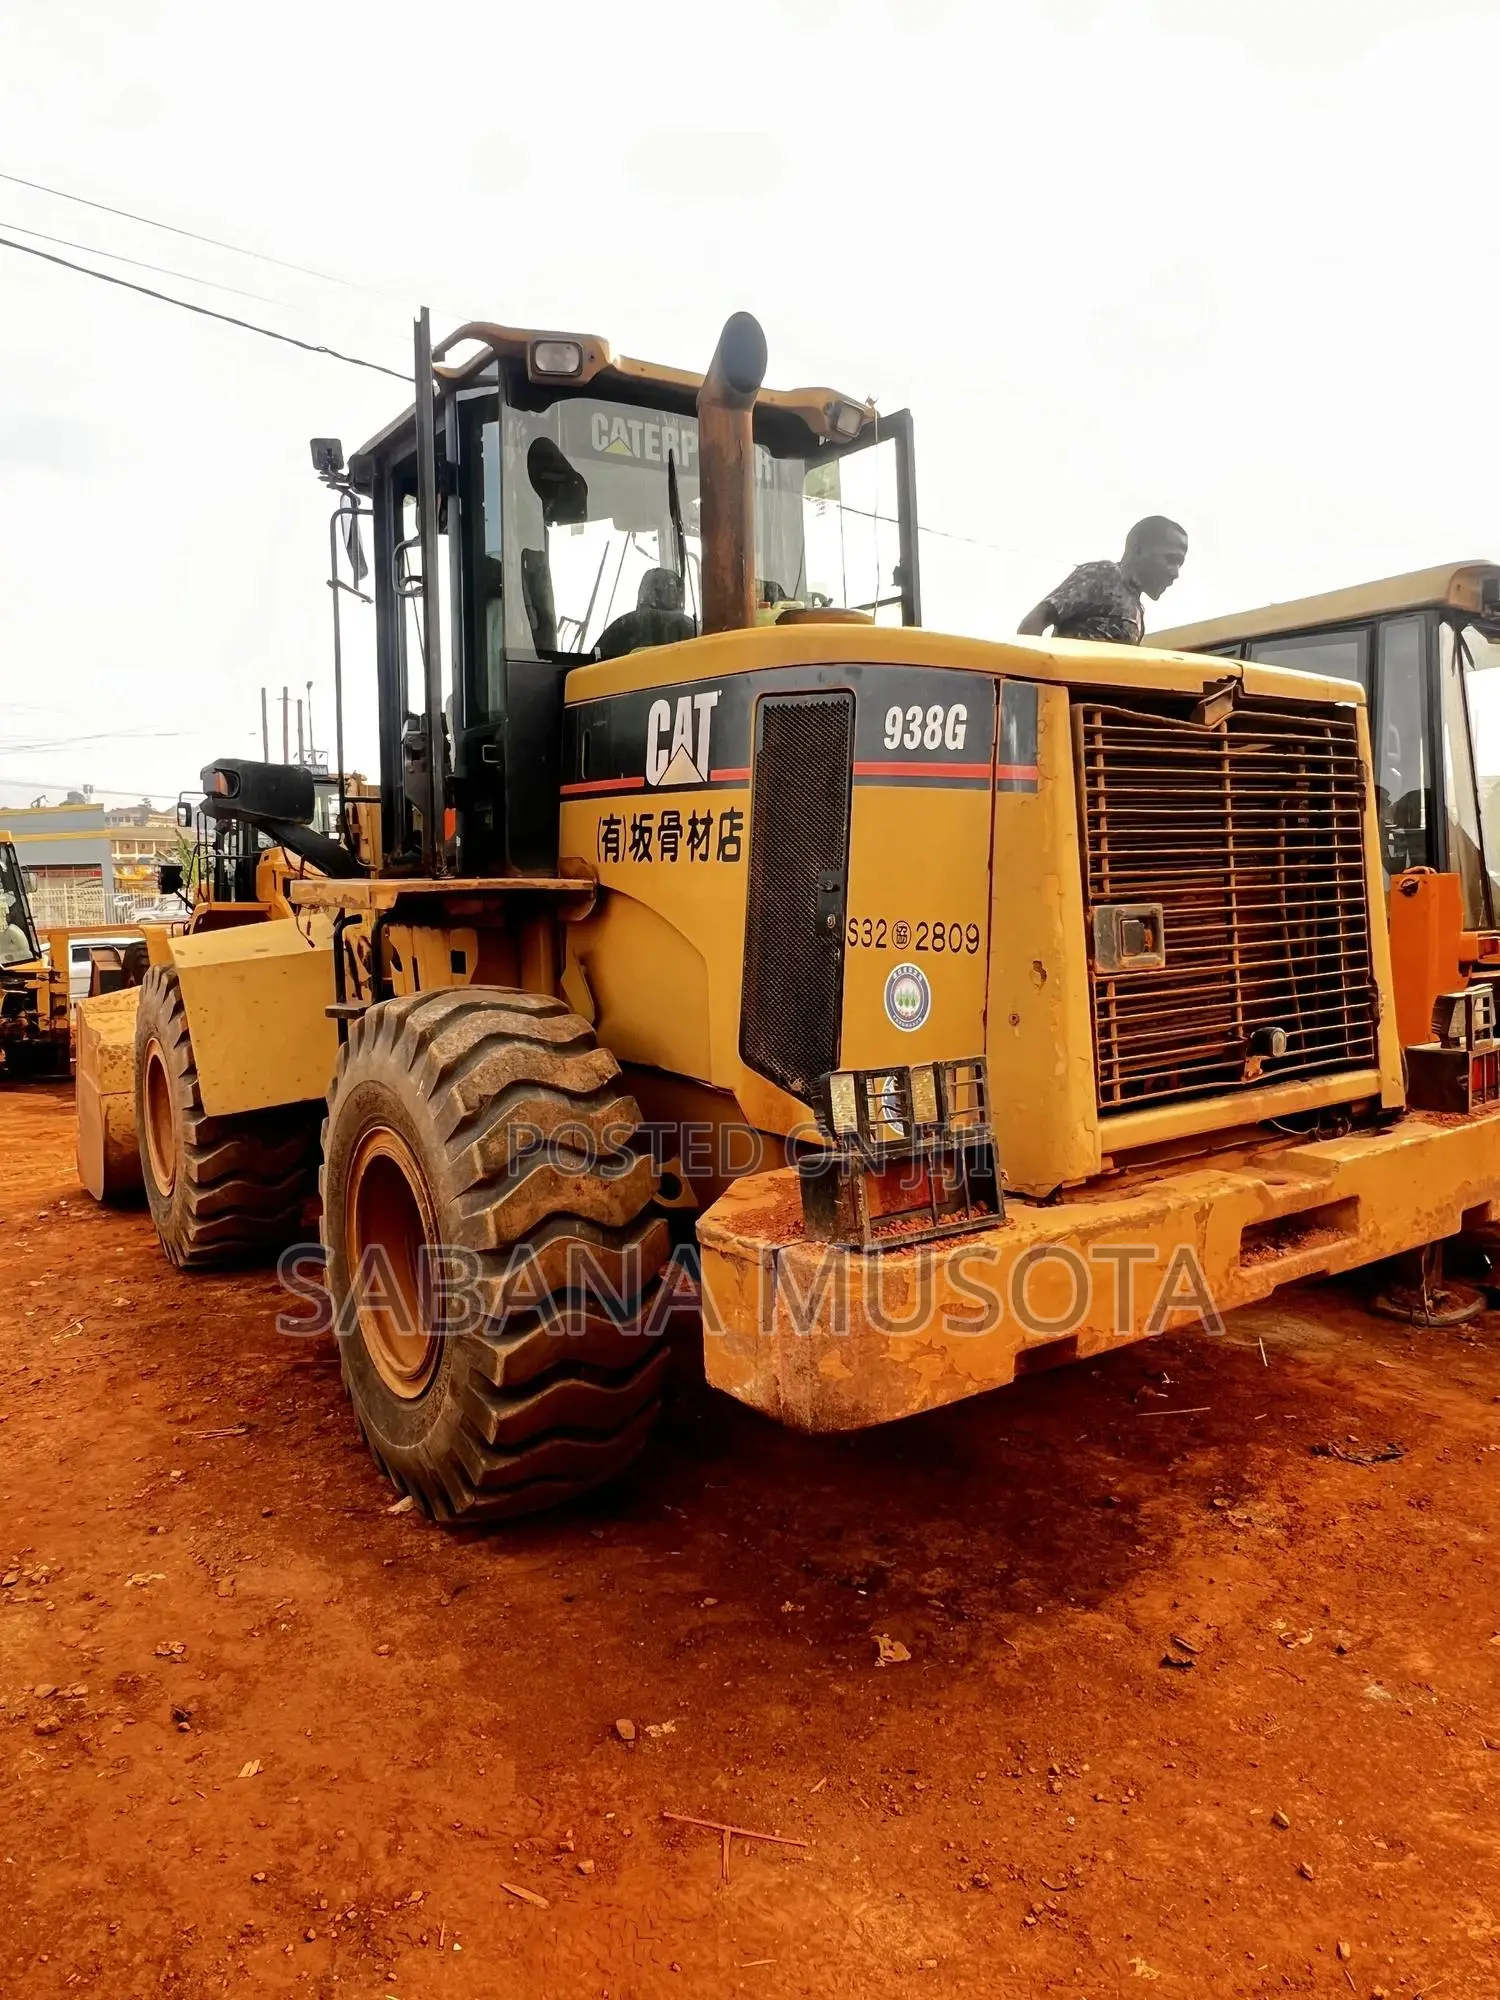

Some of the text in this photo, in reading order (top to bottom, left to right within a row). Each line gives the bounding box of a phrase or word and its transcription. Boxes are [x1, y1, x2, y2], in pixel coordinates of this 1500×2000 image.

[646, 691, 719, 786] CAT
[884, 704, 967, 750] 938G
[847, 918, 887, 948] S32
[915, 921, 980, 954] 2809
